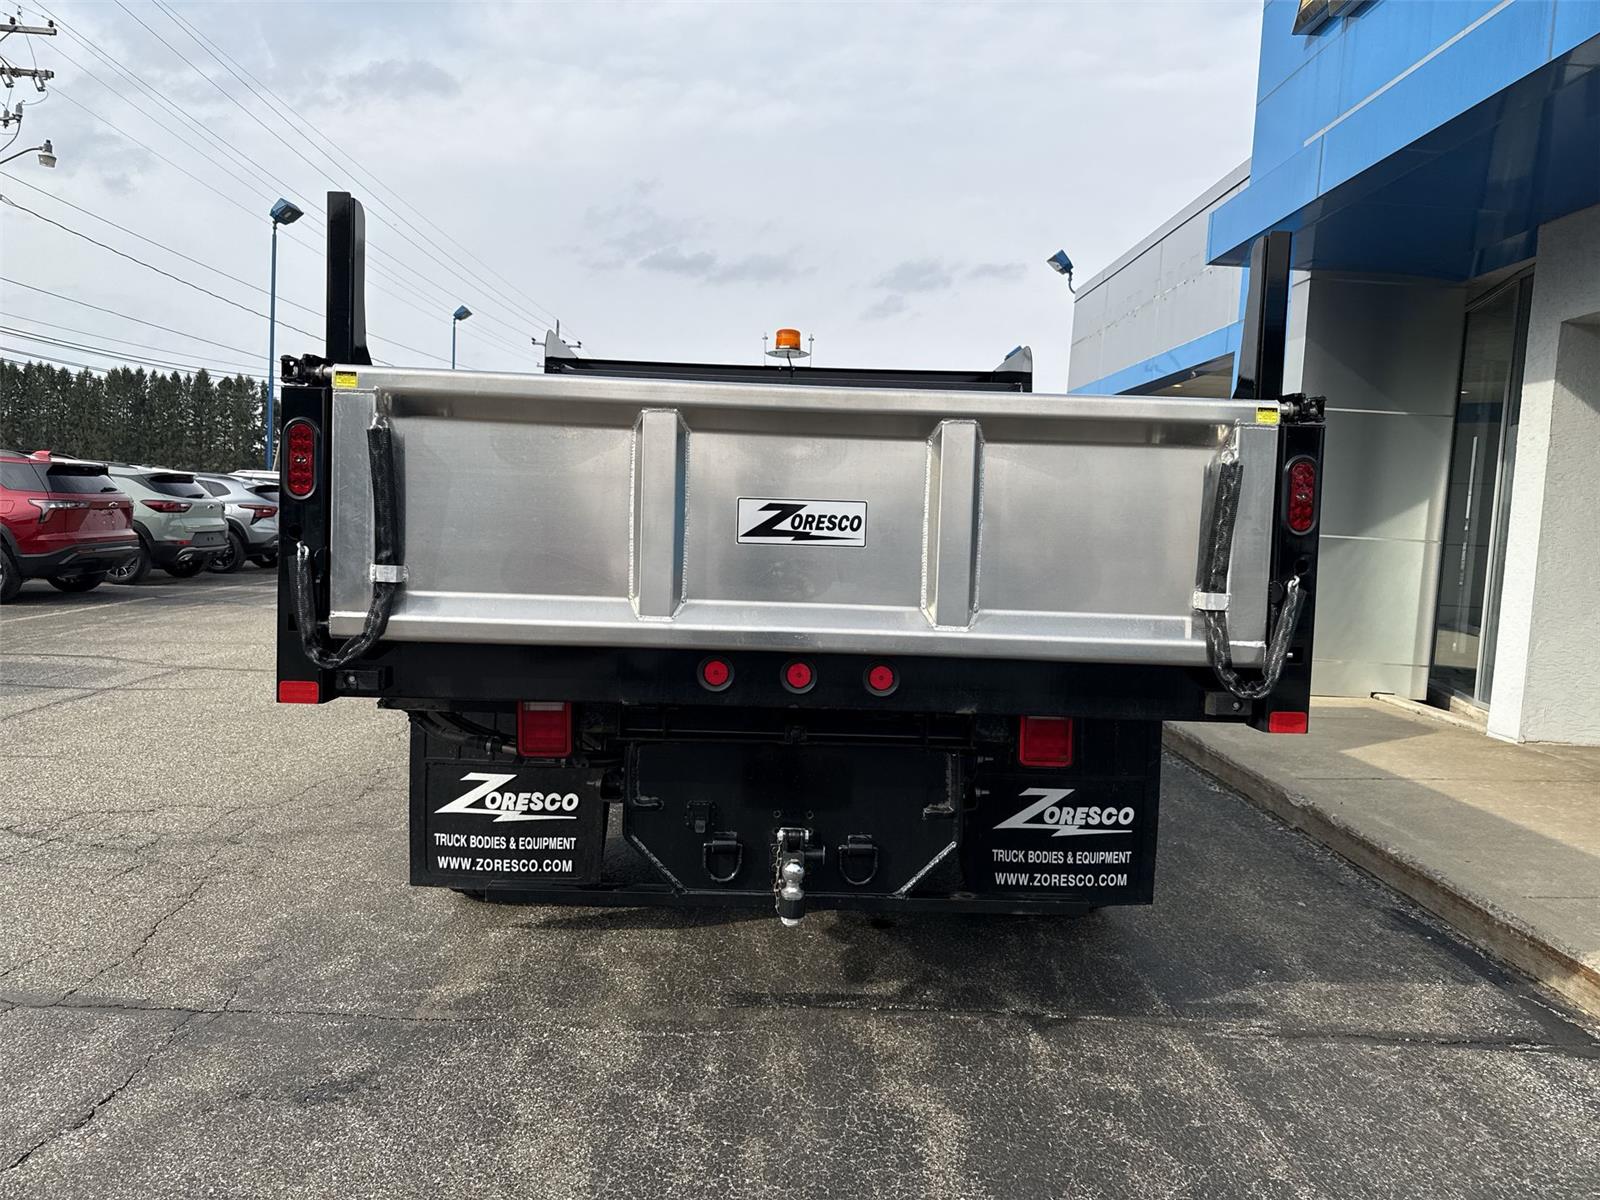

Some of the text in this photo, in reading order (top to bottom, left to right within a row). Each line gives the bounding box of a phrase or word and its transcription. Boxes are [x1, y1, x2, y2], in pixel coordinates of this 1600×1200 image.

[739, 502, 862, 541] ZORESCO
[434, 772, 579, 822] ZORESCO
[992, 787, 1135, 837] ZORESCO
[434, 833, 576, 850] TRUCK BODIES & EQUIPMENT
[437, 856, 573, 872] WWW.ZORESCO.COM
[992, 849, 1132, 864] TRUCK BODIES & EQUIPMENT
[994, 872, 1128, 887] WWW.ZORESCO.COM
